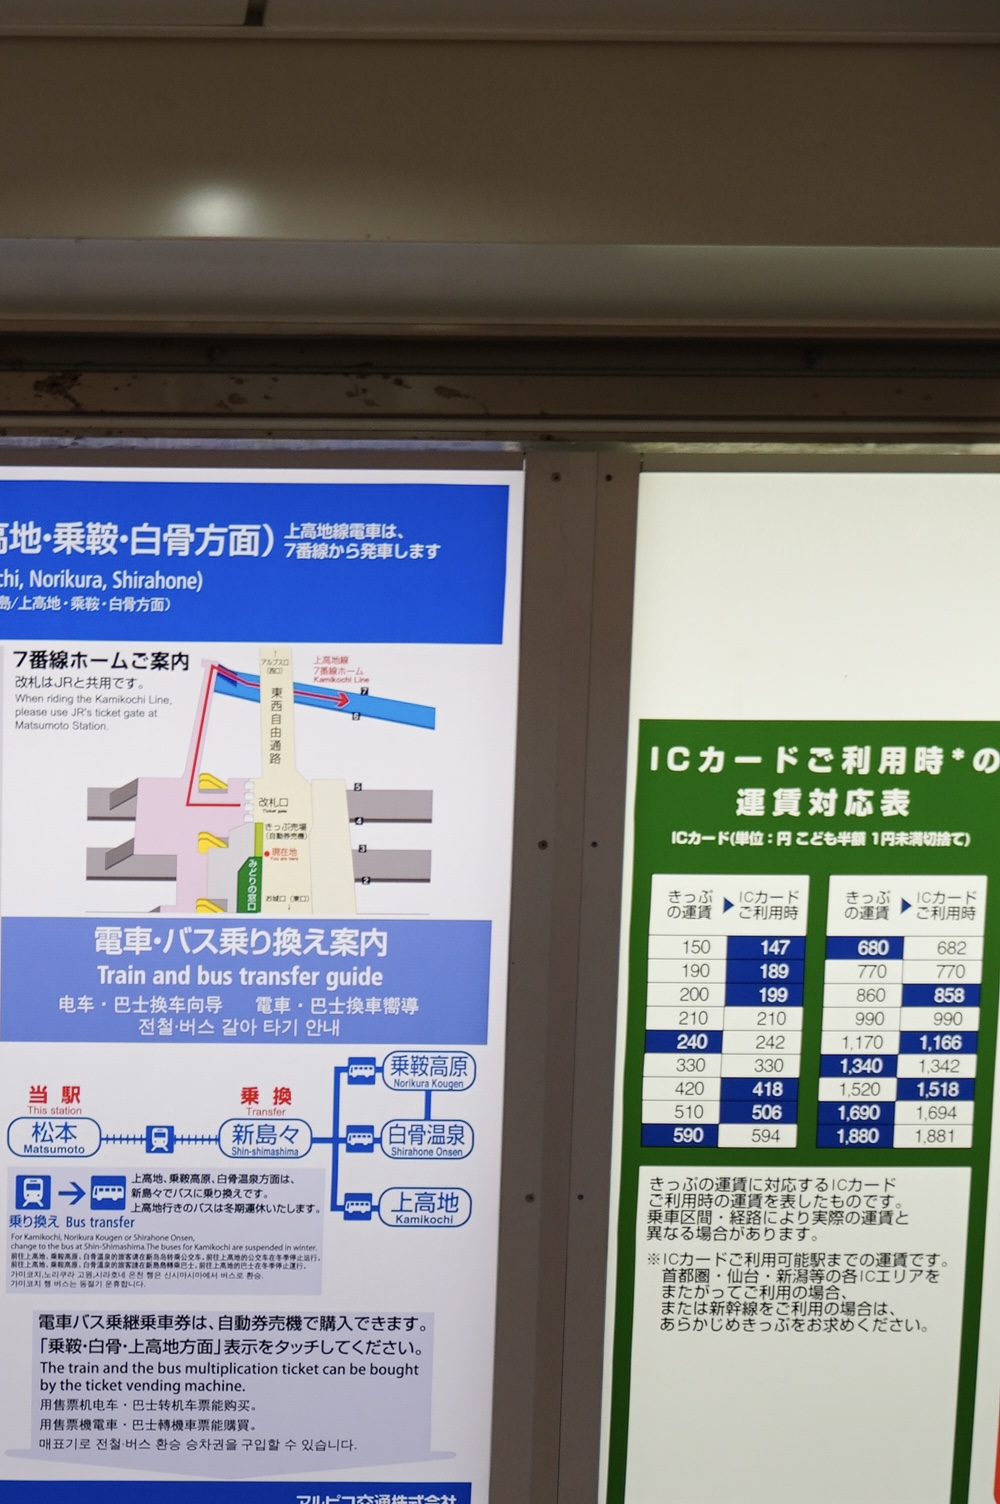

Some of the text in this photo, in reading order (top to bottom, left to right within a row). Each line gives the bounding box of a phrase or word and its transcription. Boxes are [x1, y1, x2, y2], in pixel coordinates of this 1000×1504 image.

[284, 523, 403, 539] 上高地線電車は、
[284, 542, 441, 559] 7番線から発車します
[30, 569, 107, 591] Norikura,
[113, 570, 203, 592] Shirahone)
[14, 650, 188, 671] 7番線ホームご案内
[314, 656, 348, 664] 上高地線
[16, 676, 142, 689] 改札はJRと共用です。
[15, 694, 172, 705] When riding the Kamikochi Line,
[259, 798, 288, 807] 改札口
[736, 788, 910, 816] 運賃対応表
[272, 848, 297, 856] 現在地
[95, 926, 387, 957] 電車・バス乗り換え案内
[683, 940, 966, 955] 150 147 680 682
[97, 965, 383, 991] Train and bus transfer guide
[391, 1055, 468, 1077] 乗鞍高原
[32, 1122, 77, 1143] 松本
[233, 1124, 299, 1145] 新島々
[389, 1124, 464, 1145] 白骨温泉
[674, 1127, 953, 1145] 590 594 1,880 1,881
[24, 1145, 85, 1154] Matsumoto
[231, 1147, 299, 1159] Shin-shimashima
[391, 1192, 459, 1213] 上高地
[9, 1215, 135, 1228] 乗り換え Bus transfer
[396, 1215, 453, 1224] Kamikochi
[647, 1226, 817, 1241] 異なる場合があります。
[40, 1362, 318, 1377] The train and the bus multiplication ticket
